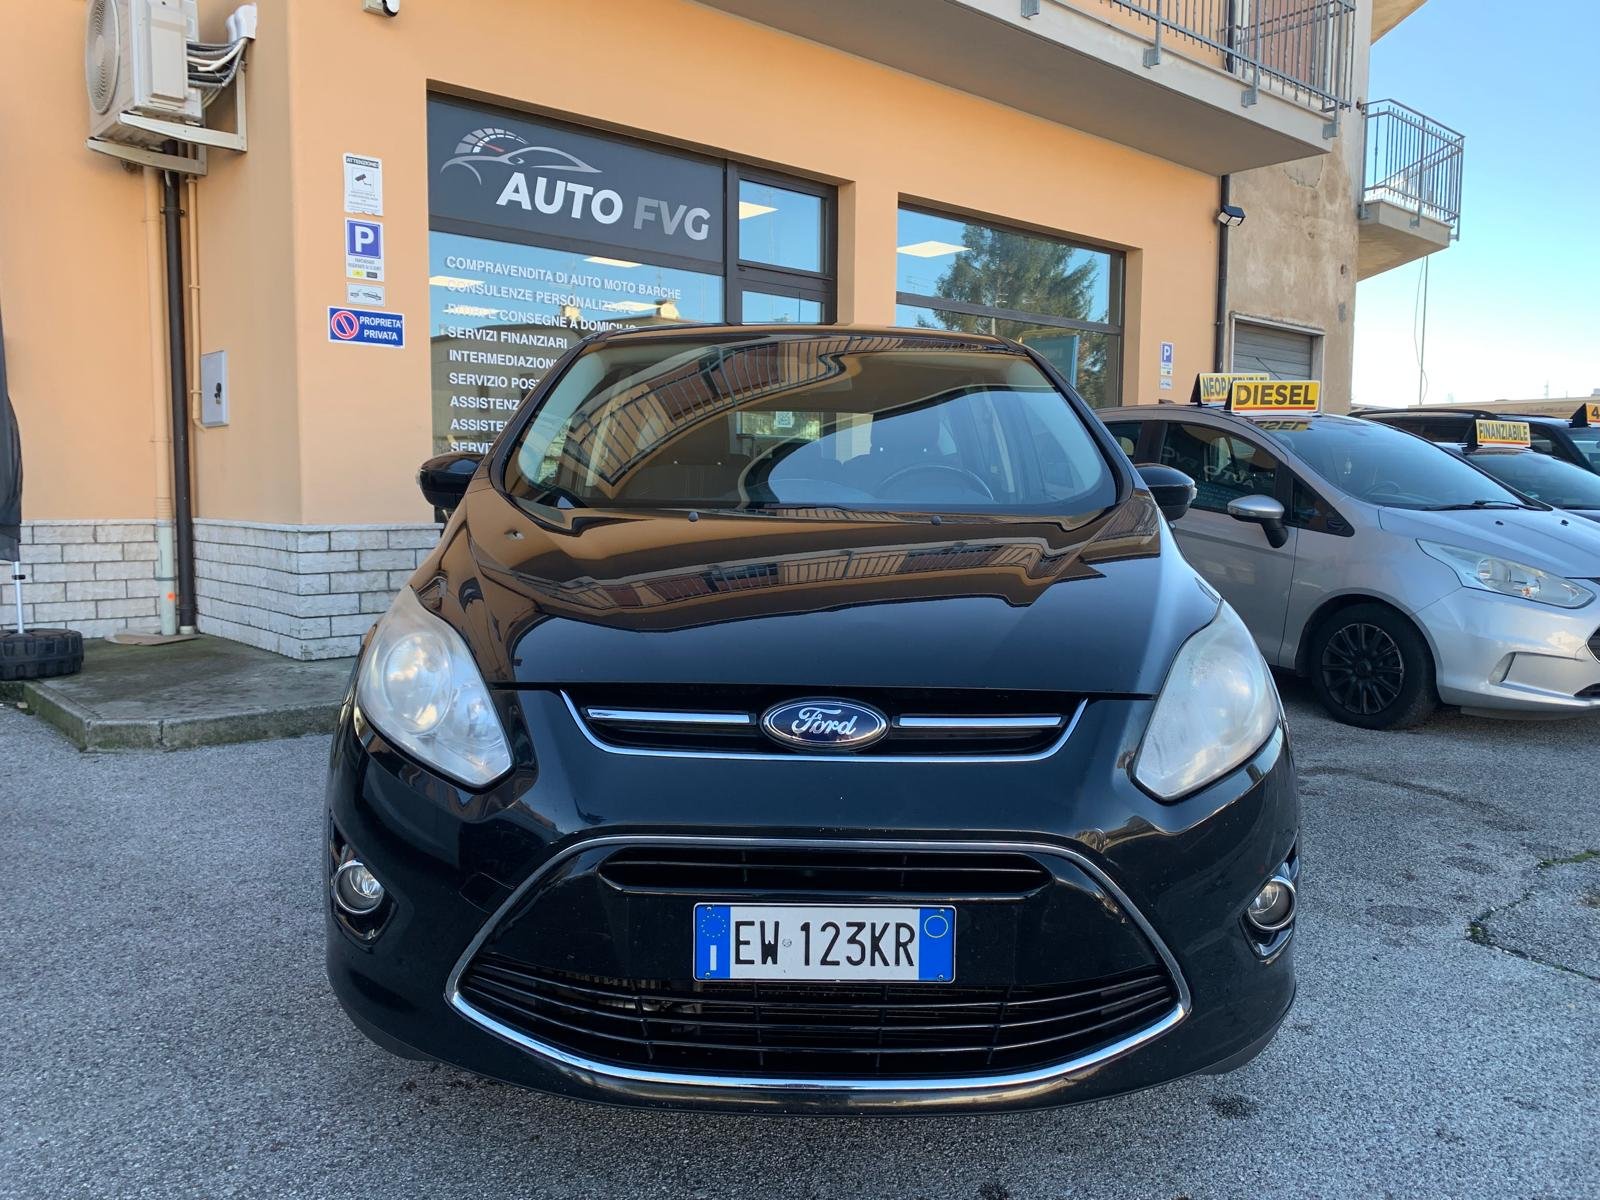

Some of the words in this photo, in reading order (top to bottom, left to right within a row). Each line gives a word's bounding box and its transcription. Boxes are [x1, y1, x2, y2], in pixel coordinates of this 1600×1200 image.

[495, 171, 623, 225] AUTO
[633, 196, 711, 241] FVG
[355, 225, 375, 252] P
[447, 256, 553, 282] COMPRAVENDITA
[556, 271, 568, 283] DI
[570, 275, 601, 289] AUTO
[604, 279, 636, 293] MOTO
[639, 284, 681, 300] BARCHE
[448, 279, 534, 301] CONSULENZE
[360, 315, 403, 328] PROPRIETA'
[500, 309, 567, 328] CONSEGNE
[569, 316, 579, 329] A
[363, 329, 398, 341] PRIVATA
[448, 326, 497, 342] SERVIZI
[500, 331, 568, 349] FINANZIARI
[449, 372, 508, 388] SERVIZIO
[1235, 384, 1315, 406] DIESEL
[1478, 422, 1528, 441] FINANZIABILE
[791, 706, 858, 736] Ford
[734, 920, 780, 965] EW
[800, 921, 916, 967] 123KR
